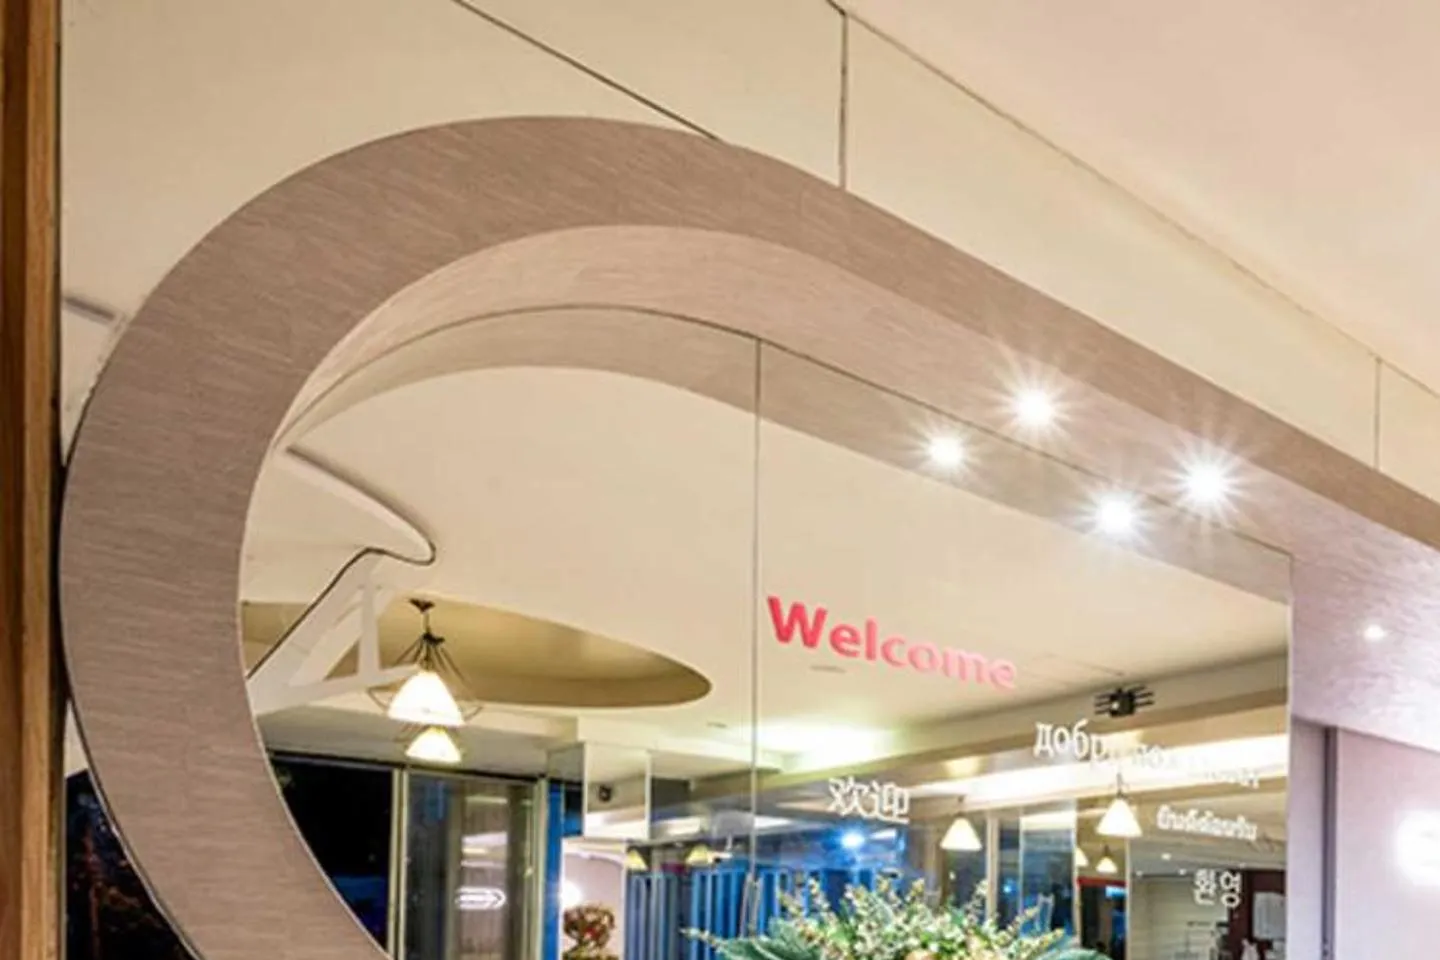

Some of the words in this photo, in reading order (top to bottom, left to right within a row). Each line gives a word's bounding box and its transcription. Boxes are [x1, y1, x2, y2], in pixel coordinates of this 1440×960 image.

[766, 594, 1016, 690] Welcome
[1034, 718, 1123, 766] добр
[827, 776, 911, 824] 欢迎
